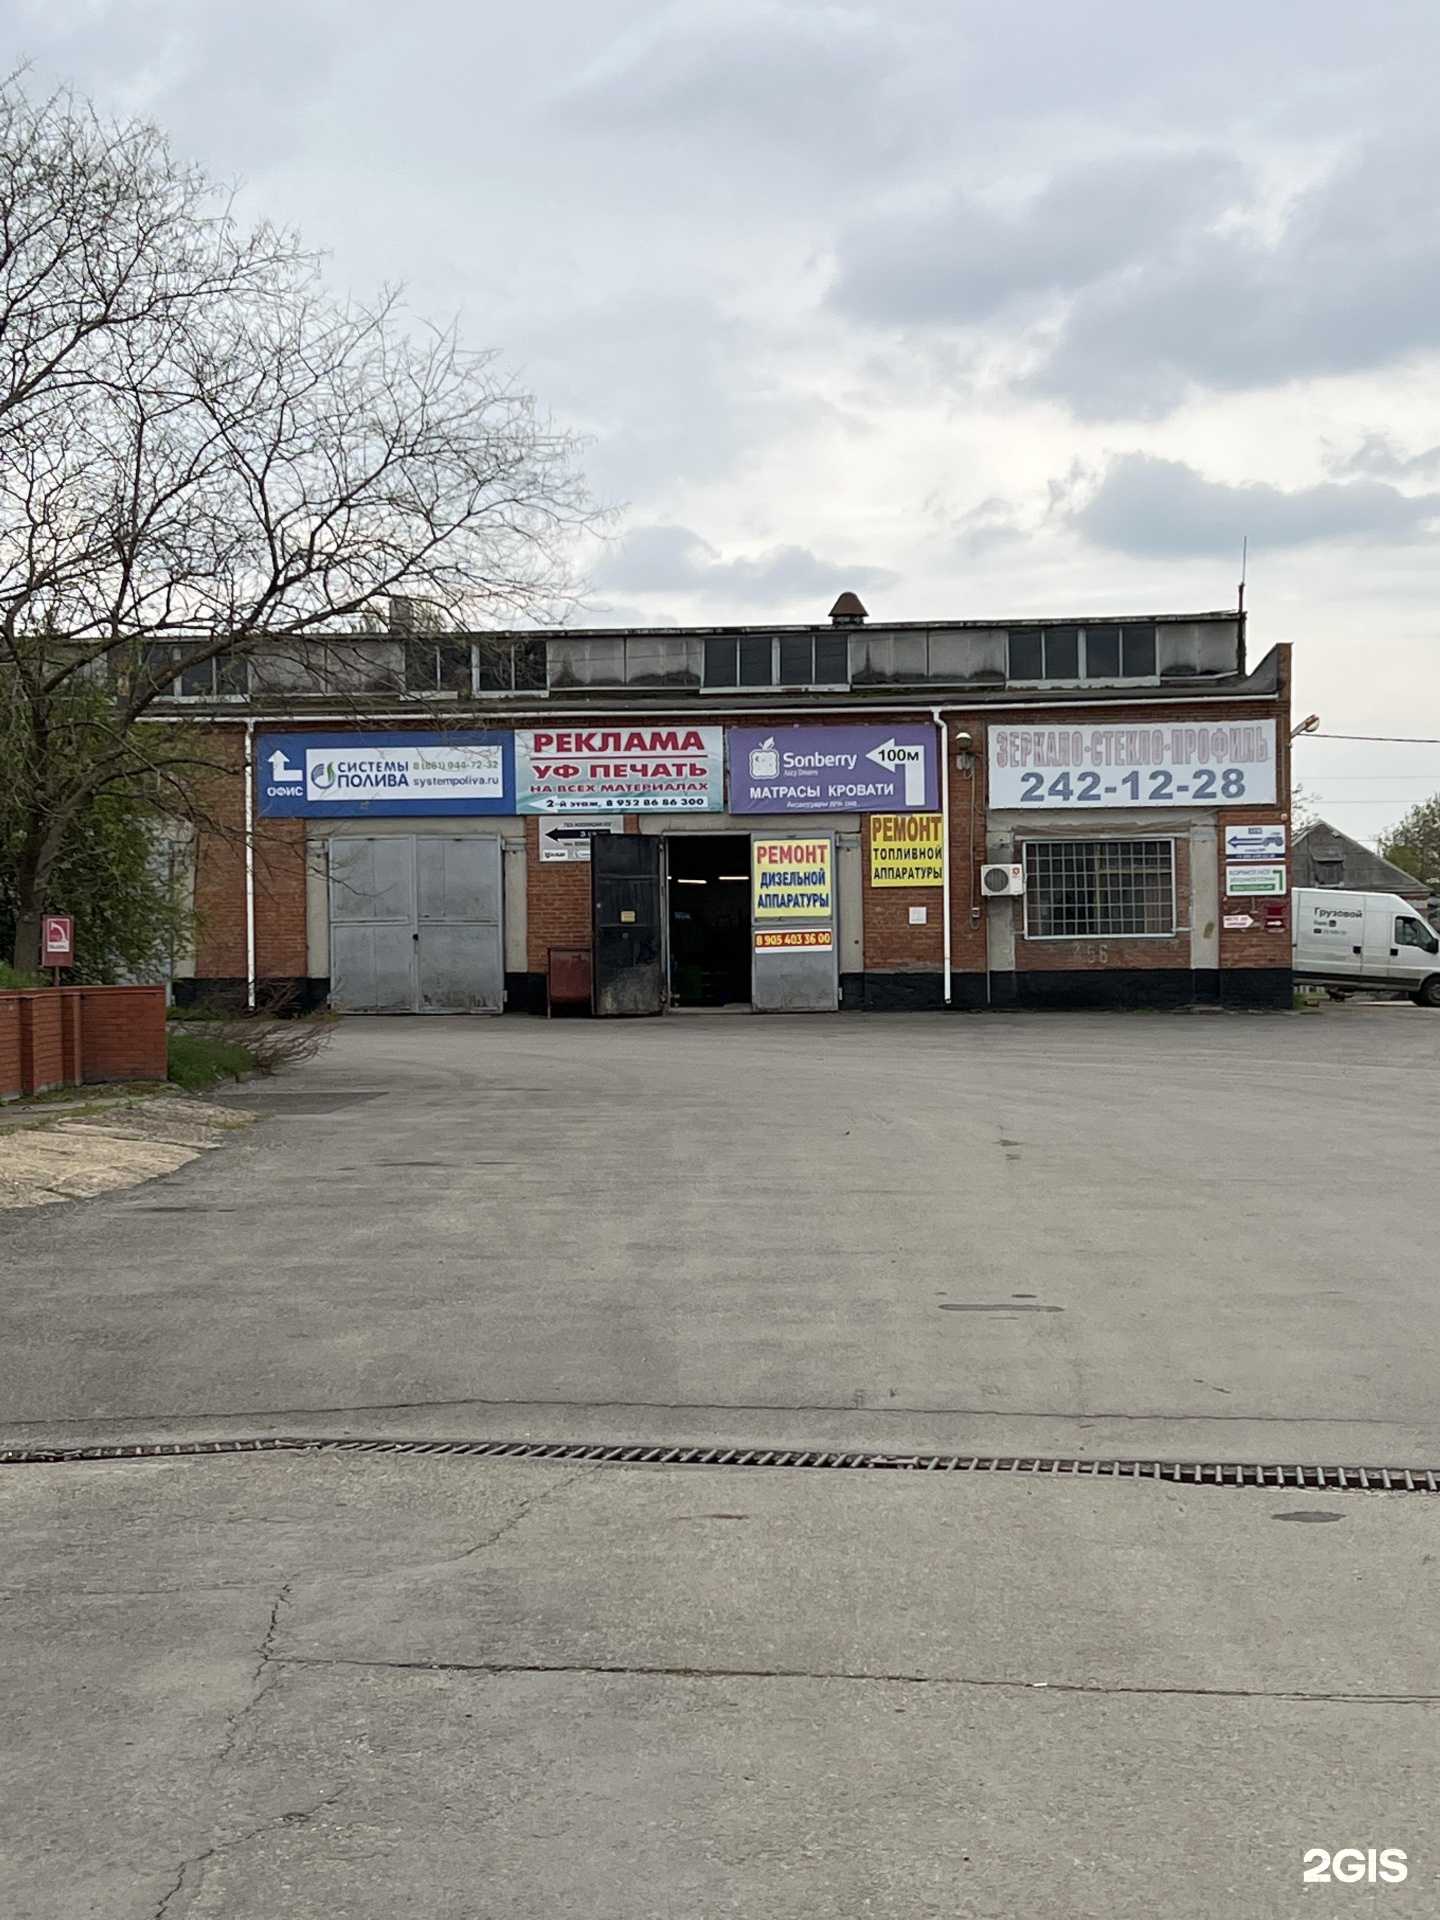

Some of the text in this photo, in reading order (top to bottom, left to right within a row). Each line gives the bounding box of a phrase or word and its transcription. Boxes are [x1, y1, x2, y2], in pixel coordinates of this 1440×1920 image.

[533, 730, 705, 753] РЕКЛАМА
[337, 761, 409, 773] СИСТЕМЫ
[783, 751, 858, 770] Sonberry
[532, 763, 708, 779] УФ ПЕЧАТЬ
[337, 773, 409, 788] ПОЛИВА
[413, 776, 499, 788] systempoliva.ru
[530, 783, 708, 793] НА ВСЕХ МАТЕРИАЛАХ
[1020, 767, 1246, 802] 242-12-28
[267, 786, 304, 797] ОФИС
[750, 783, 894, 799] МАТРАСЫ КРОВАТИ
[662, 799, 677, 807] 86
[680, 798, 704, 806] 300
[872, 816, 942, 842] РЕМОНТ
[756, 844, 828, 864] РЕМОНТ
[872, 846, 942, 861] ТОПЛИВНОЙ
[760, 867, 826, 887] ДИЗЕЛЬНОЙ
[873, 866, 942, 880] АППАРАТУРЫ
[757, 892, 829, 909] АППАРАТУРЫ
[1314, 907, 1363, 918] Грузовой
[755, 932, 831, 946] 8 905 403 36 00
